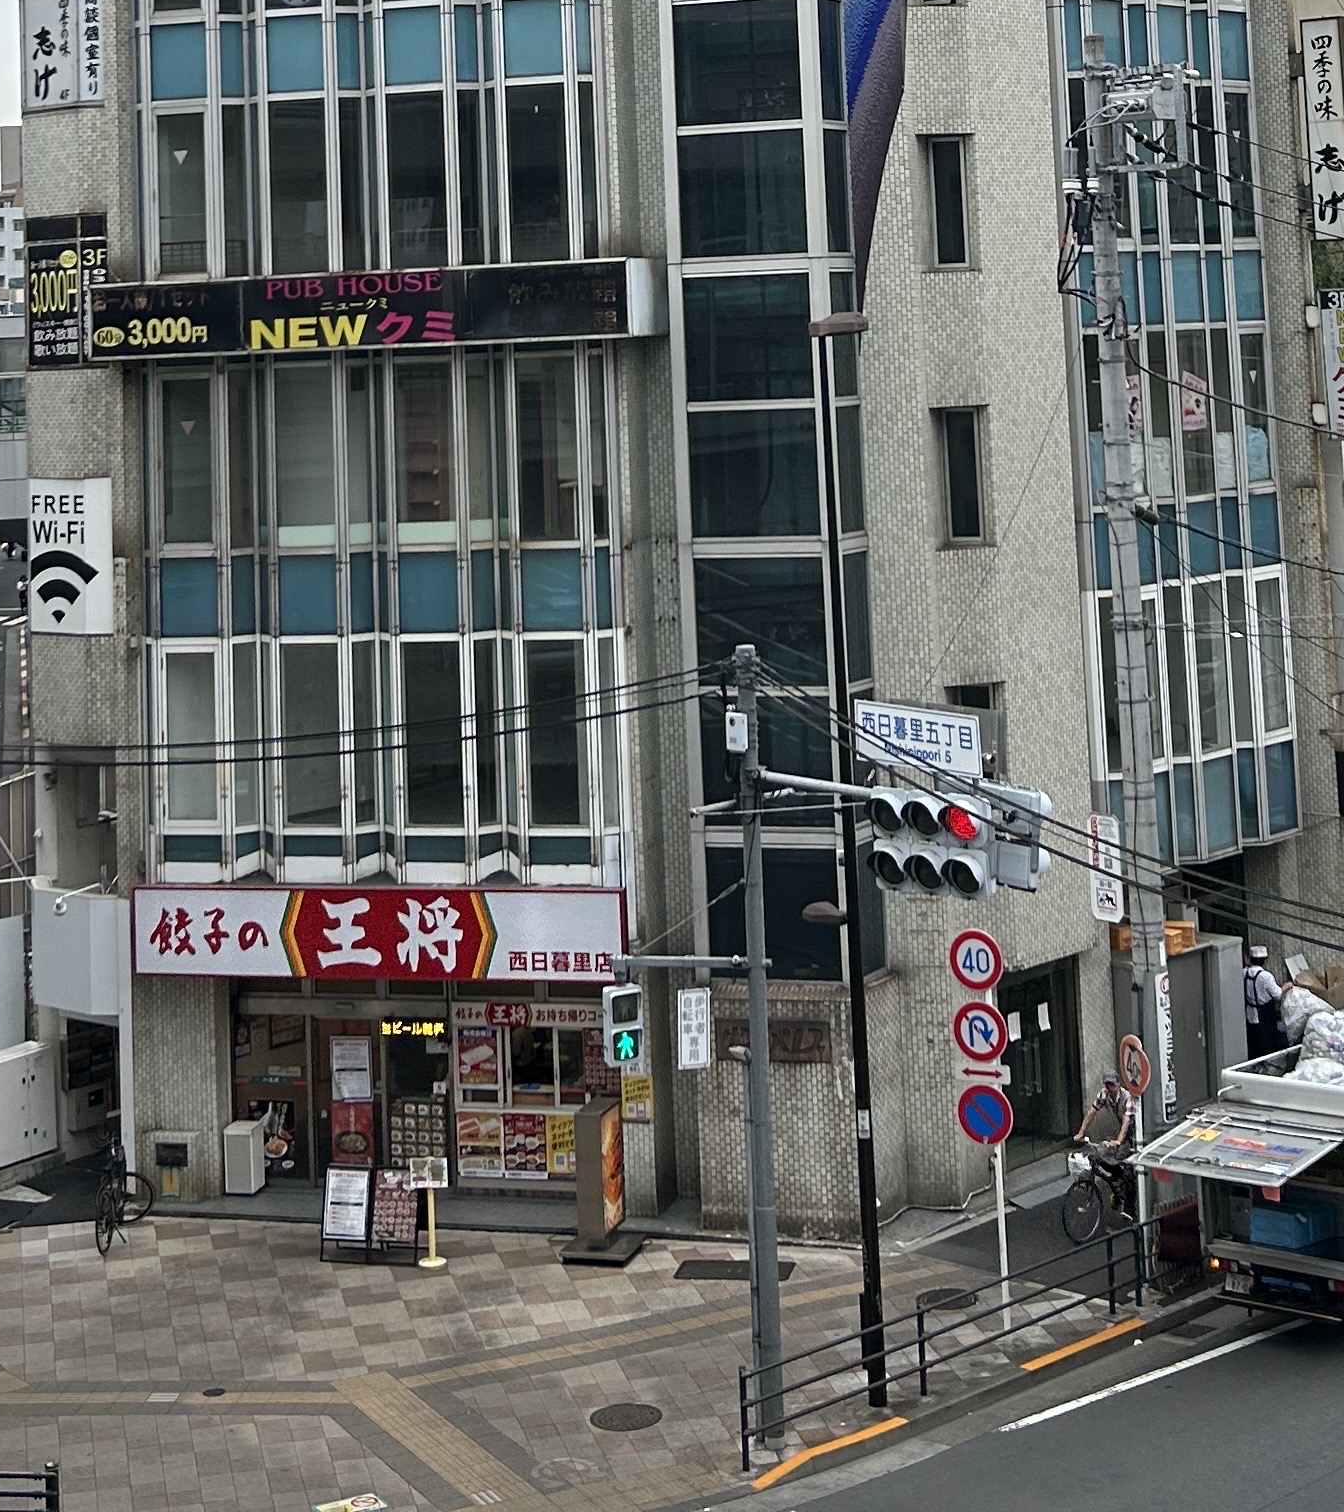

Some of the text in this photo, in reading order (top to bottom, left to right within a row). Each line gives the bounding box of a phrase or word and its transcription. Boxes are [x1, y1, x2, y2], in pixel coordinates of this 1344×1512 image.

[1311, 34, 1339, 120] 四季の味
[82, 248, 107, 266] 3F
[30, 269, 78, 318] 3,000円
[266, 270, 445, 300] PUB HOUSE
[127, 316, 208, 349] 3,000円
[250, 309, 458, 350] NEW クミ
[31, 494, 85, 514] FREE
[32, 520, 85, 545] Wi-Fi
[861, 711, 973, 750] 西日暮里五丁目
[944, 750, 952, 764] 5
[150, 895, 614, 974] 餃子の 王将 西日暮里店
[962, 947, 990, 974] 40
[492, 1004, 528, 1025] 王将
